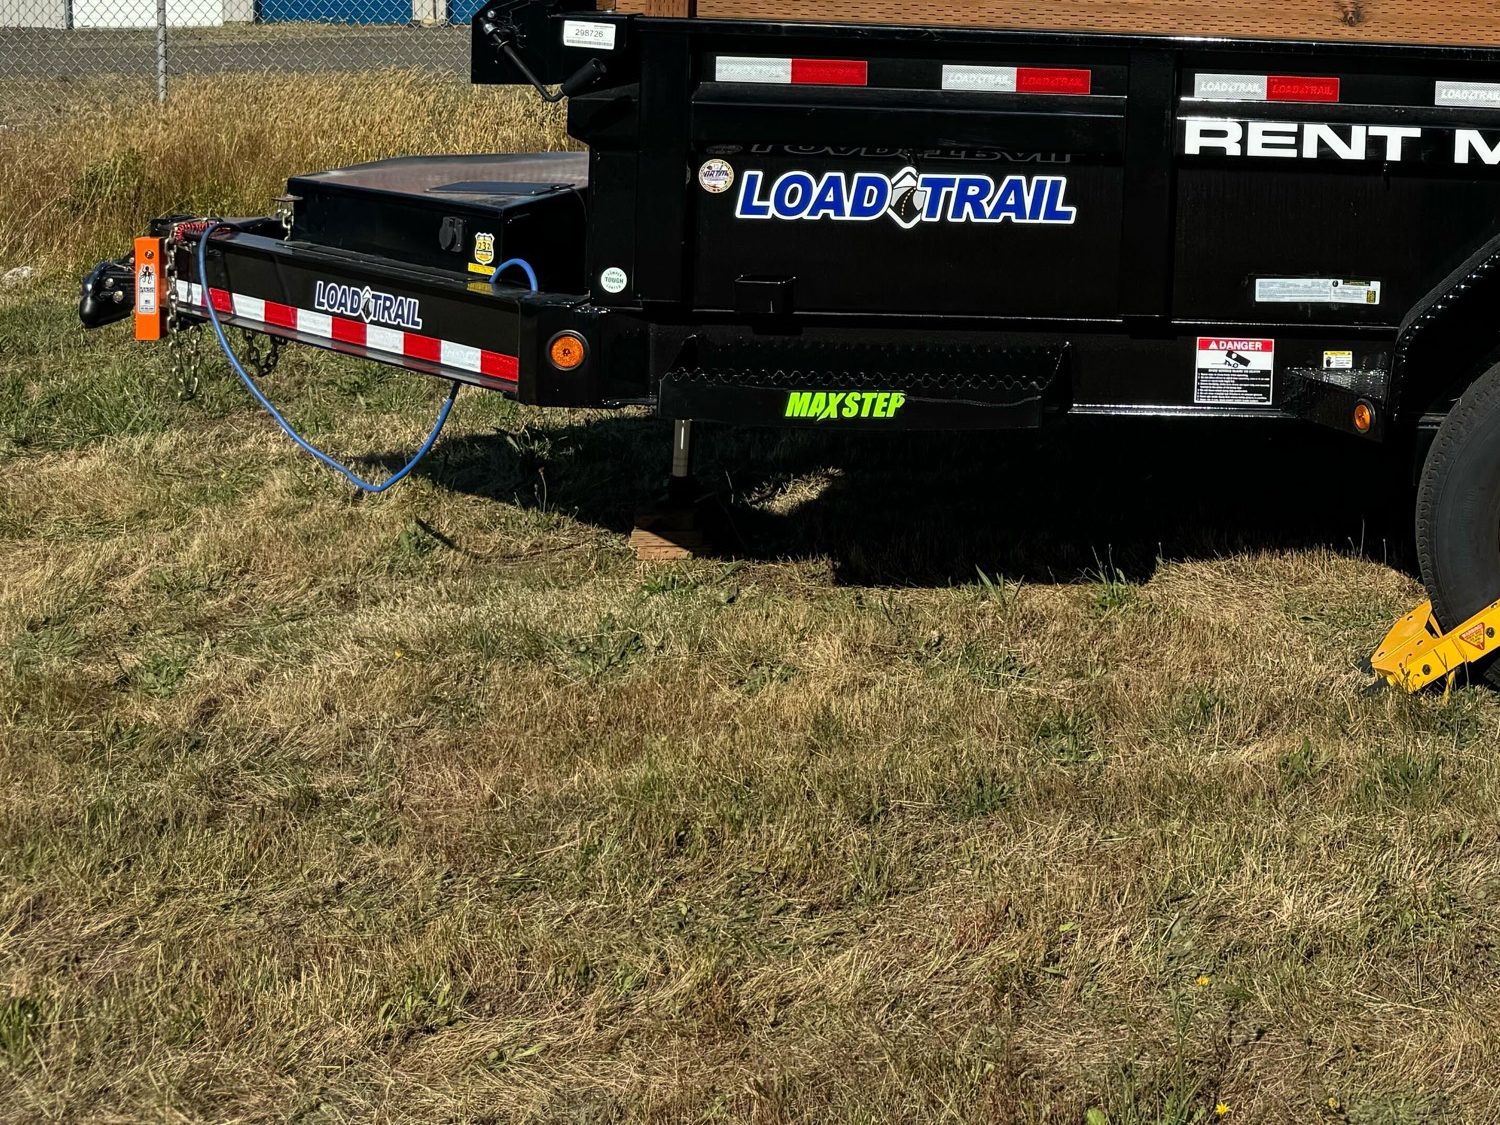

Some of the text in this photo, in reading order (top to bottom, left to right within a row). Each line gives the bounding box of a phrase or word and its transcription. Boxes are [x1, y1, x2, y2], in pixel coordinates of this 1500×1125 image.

[575, 28, 604, 38] 298726
[1184, 120, 1421, 161] RENT
[735, 171, 892, 220] LOAD
[917, 173, 1077, 224] TRAIL
[605, 276, 624, 284] TOUGH
[315, 281, 422, 329] LOAD TRAIL
[1219, 341, 1262, 350] DANGER
